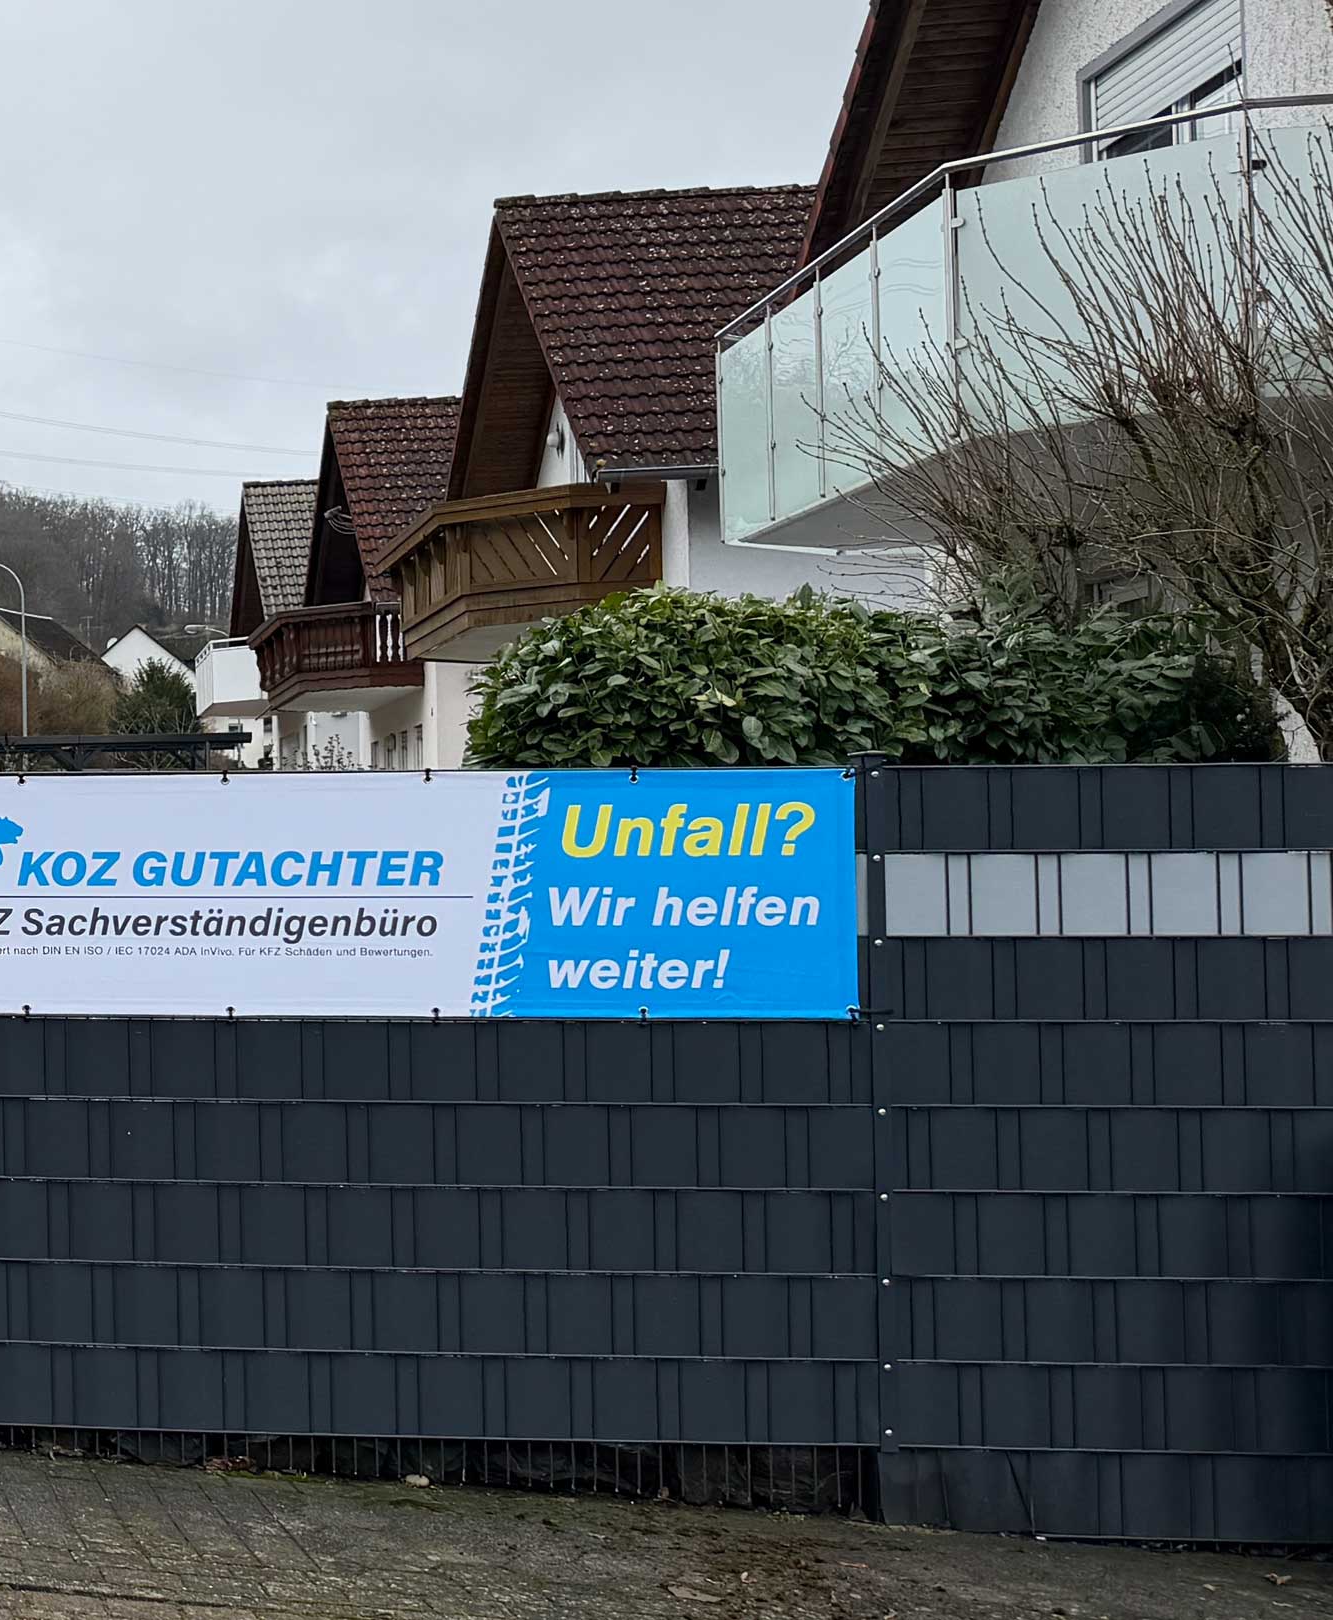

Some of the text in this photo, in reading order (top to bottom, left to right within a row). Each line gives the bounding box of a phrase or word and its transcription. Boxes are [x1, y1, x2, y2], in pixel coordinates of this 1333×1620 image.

[563, 803, 814, 857] Unfall?
[17, 850, 444, 888] KOZ GUTACHTER
[21, 907, 437, 945] Sachverständigenbüro
[549, 886, 819, 927] Wir helfen
[13, 945, 39, 956] nach
[42, 946, 62, 955] DIN
[65, 946, 80, 955] EN
[83, 946, 104, 956] ISO
[107, 946, 112, 955] /
[115, 946, 134, 956] IEC
[137, 946, 171, 956] 17024
[174, 946, 198, 956] ADA
[238, 946, 256, 957] Für
[259, 947, 281, 957] KFZ
[284, 946, 333, 957] Schäden
[336, 947, 357, 957] und
[360, 947, 433, 959] Bewertungen.
[548, 949, 730, 989] weiter!
